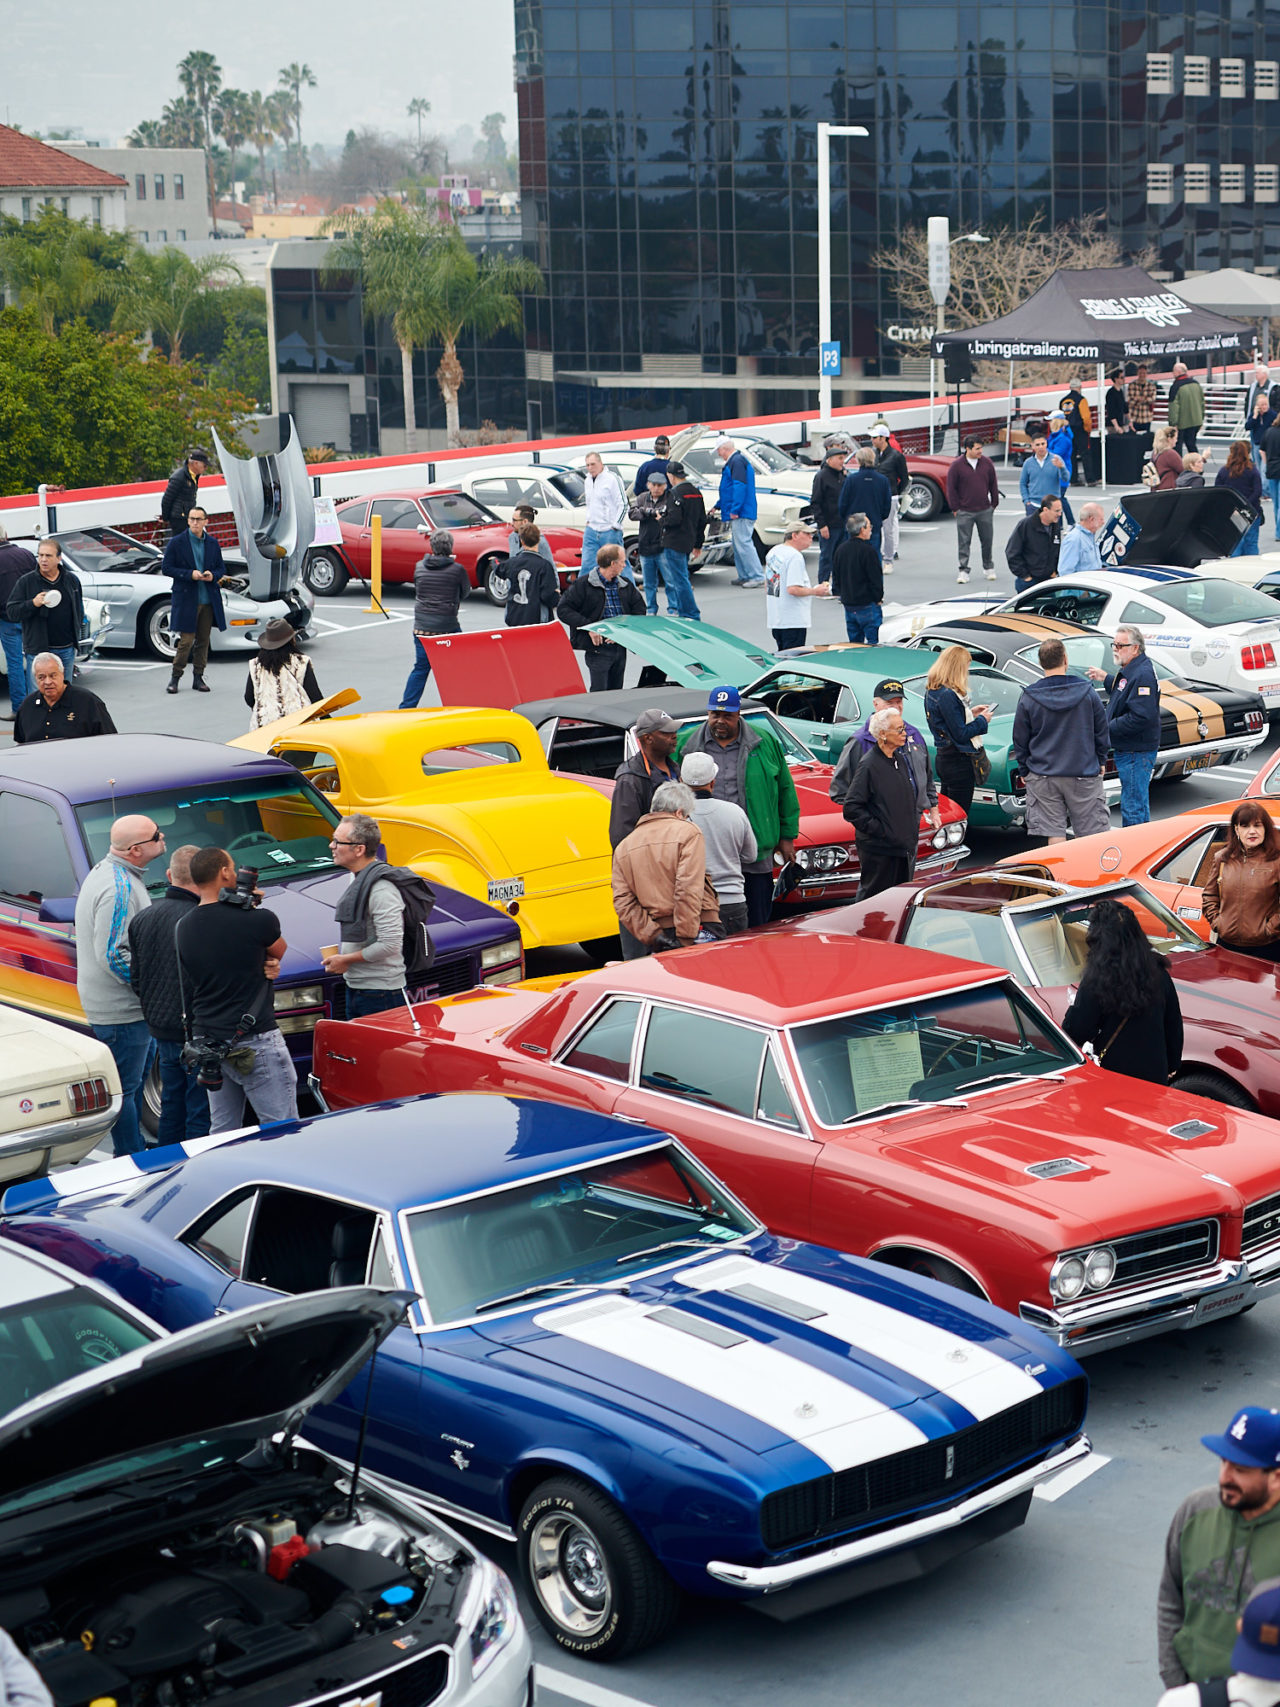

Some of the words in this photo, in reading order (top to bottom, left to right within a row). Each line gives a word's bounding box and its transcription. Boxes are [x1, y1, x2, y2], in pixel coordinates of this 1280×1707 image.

[935, 339, 1099, 359] .bringatrailer.com
[1123, 342, 1141, 357] This
[1140, 341, 1148, 355] is
[1148, 340, 1165, 354] how
[1164, 337, 1197, 353] auctions
[1197, 335, 1222, 350] should
[823, 349, 839, 368] P3
[716, 691, 729, 702] D
[406, 983, 441, 1003] MC
[521, 1497, 552, 1532] Radial
[554, 1497, 575, 1511] T/A
[555, 1611, 620, 1653] BFGoodrich
